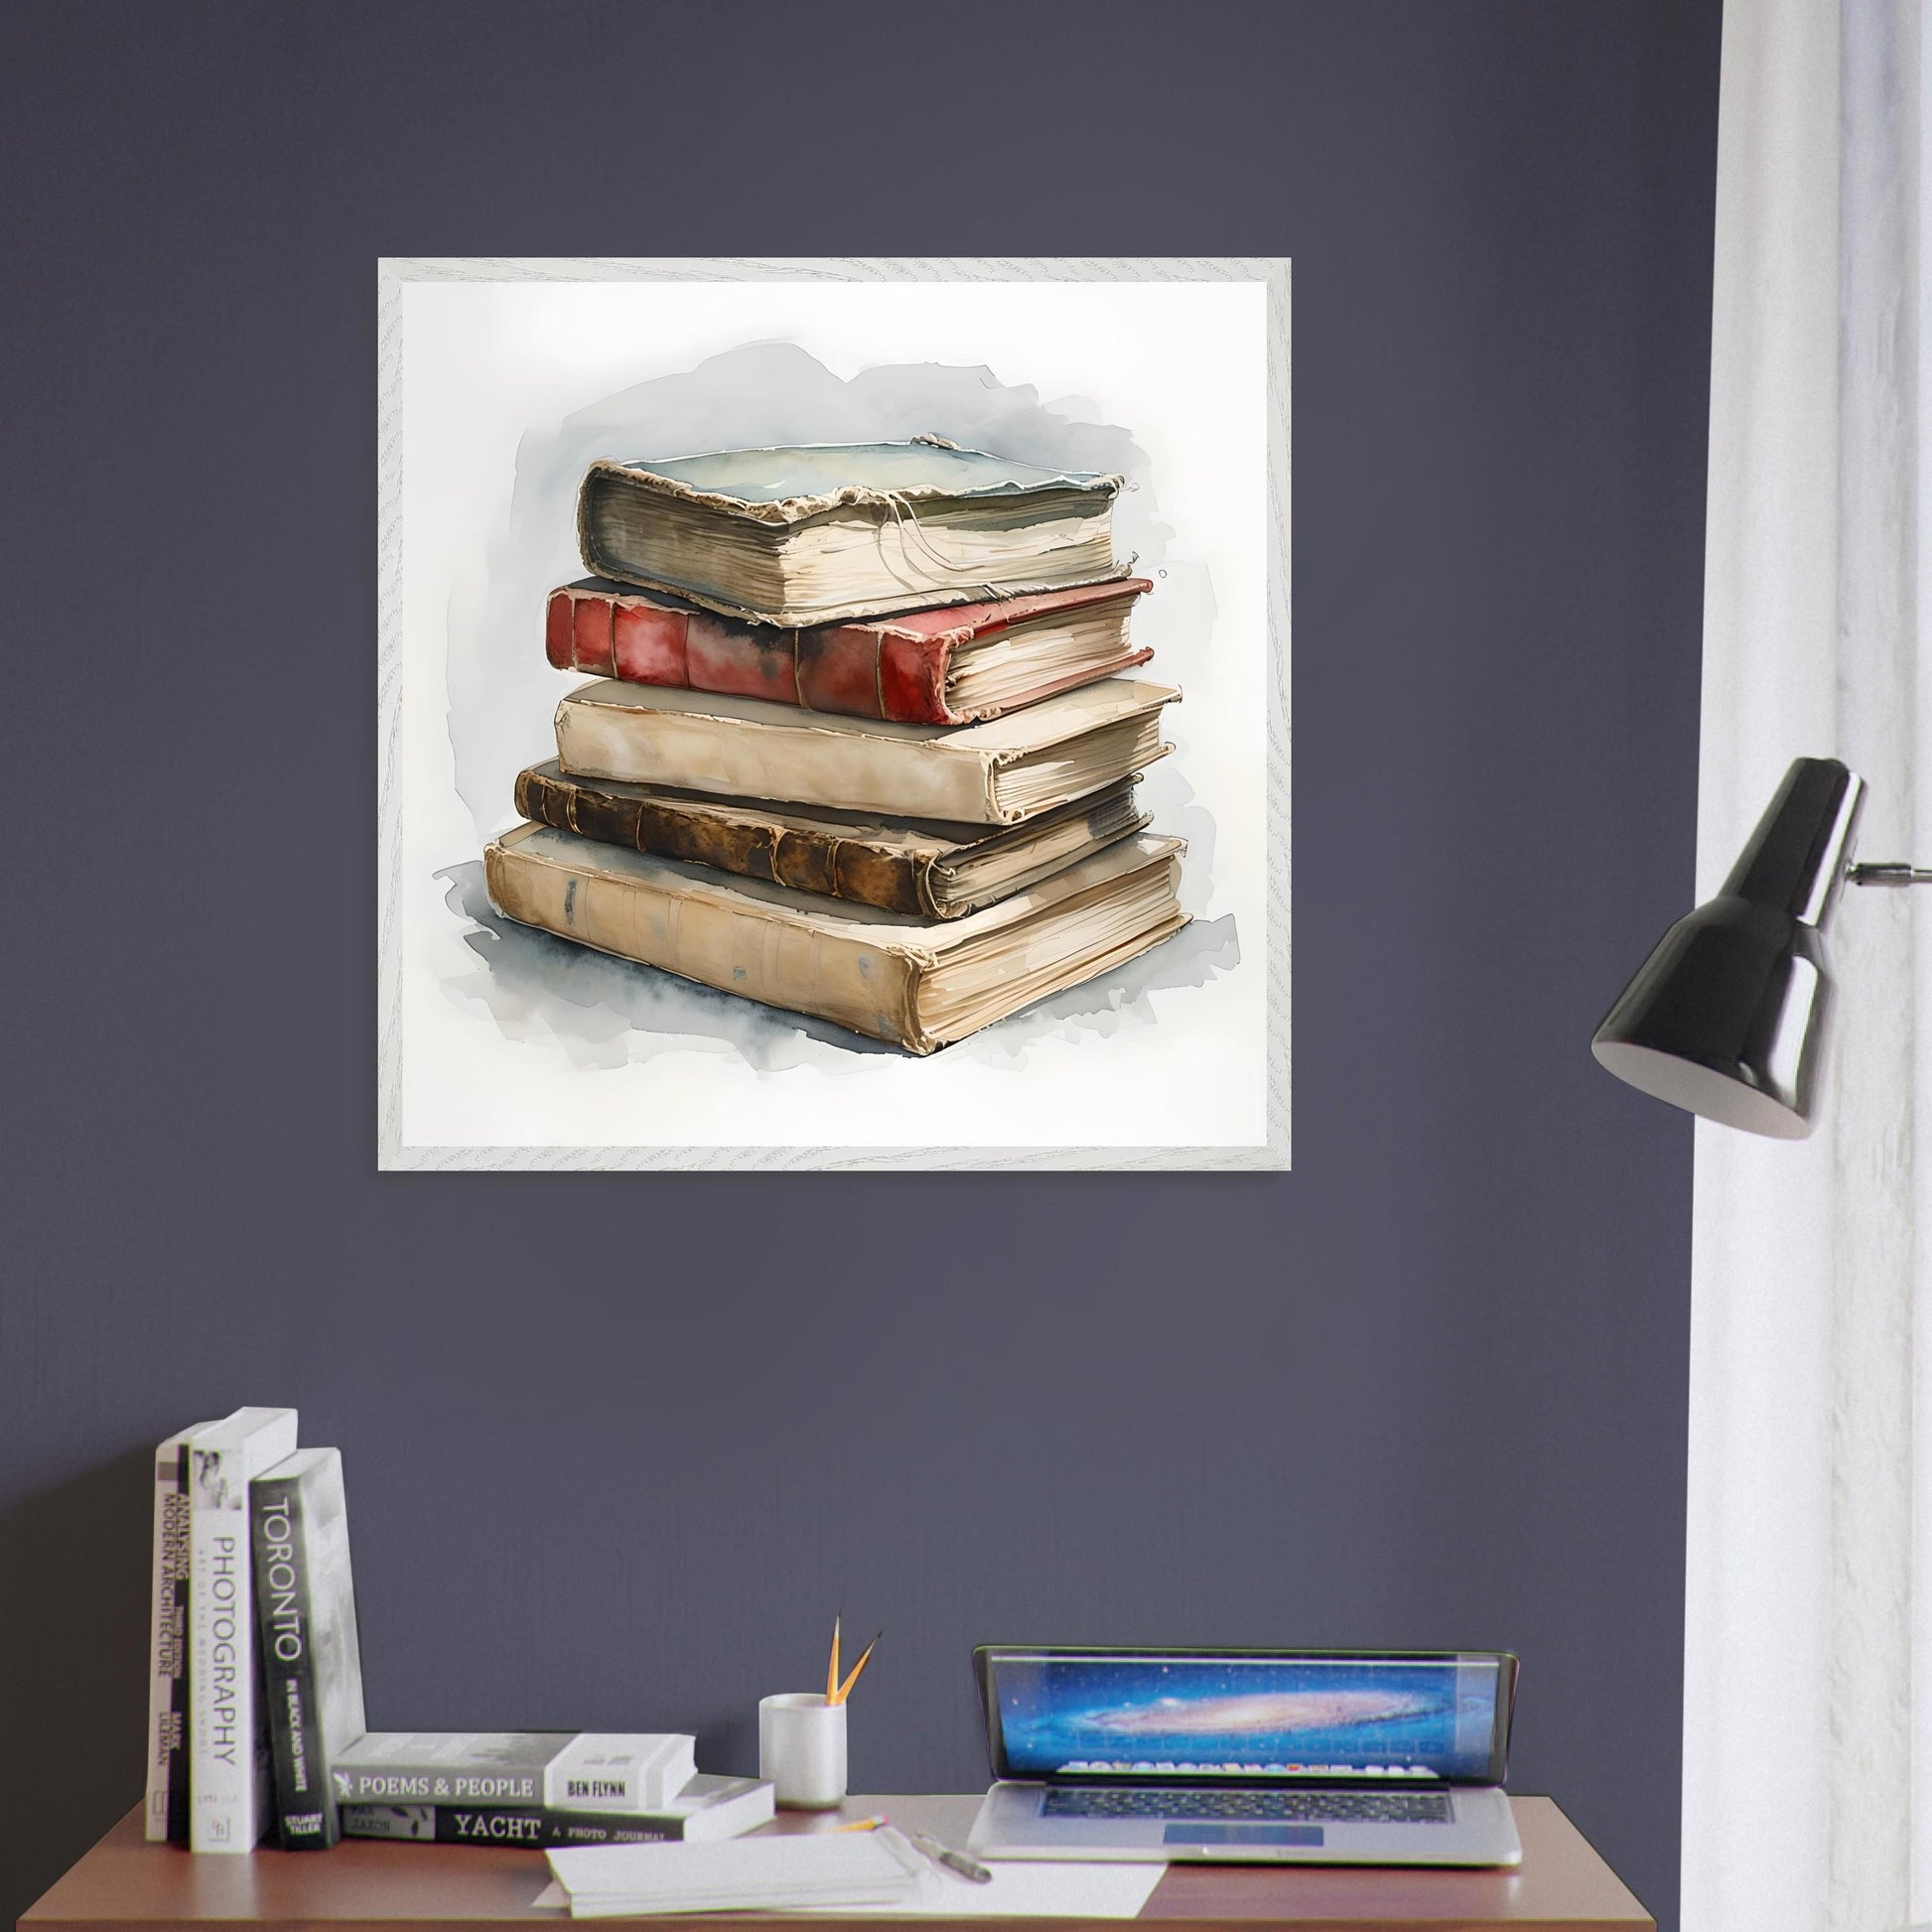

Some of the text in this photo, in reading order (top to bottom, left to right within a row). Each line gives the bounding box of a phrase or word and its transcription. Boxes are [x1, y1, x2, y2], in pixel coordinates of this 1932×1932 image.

[176, 1492, 190, 1580] ANALYSING
[262, 1495, 302, 1661] TORONTO
[158, 1493, 176, 1677] MODERN ARCHITECTURE
[212, 1537, 235, 1765] PHOTOGRAPHY
[170, 1712, 183, 1749] MARK
[286, 1678, 307, 1792] IN BLACK AND WHITE
[359, 1776, 534, 1797] POEMS & PEOPLE
[454, 1813, 541, 1839] YACHT
[552, 1826, 562, 1837] A
[568, 1827, 607, 1840] PHOTO
[568, 1780, 625, 1797] BEN FLYNN
